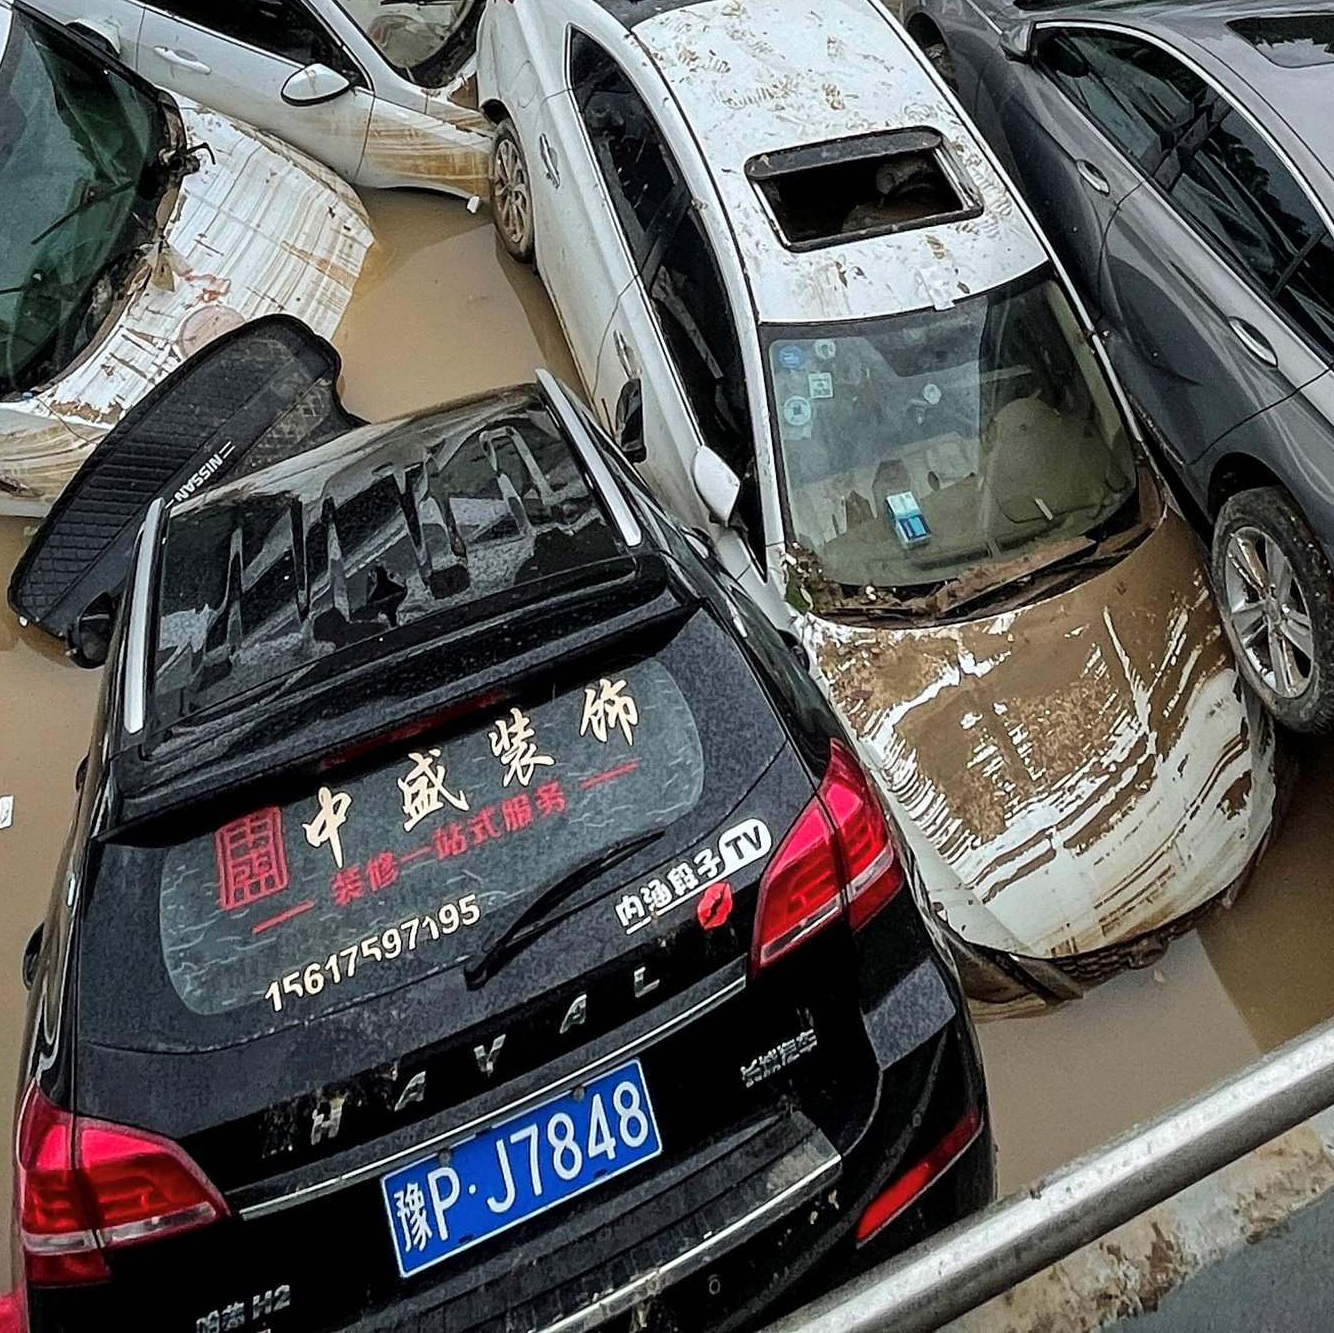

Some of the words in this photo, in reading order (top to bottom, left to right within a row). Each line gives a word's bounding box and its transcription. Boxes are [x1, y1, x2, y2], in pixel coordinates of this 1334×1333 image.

[174, 453, 223, 502] NISSAN
[300, 677, 639, 869] 中盛装饰
[330, 780, 566, 907] 装修一站式服务
[264, 893, 483, 1013] 15617597195
[310, 966, 661, 1146] HAVAL
[393, 1079, 651, 1253] 豫P·J7848
